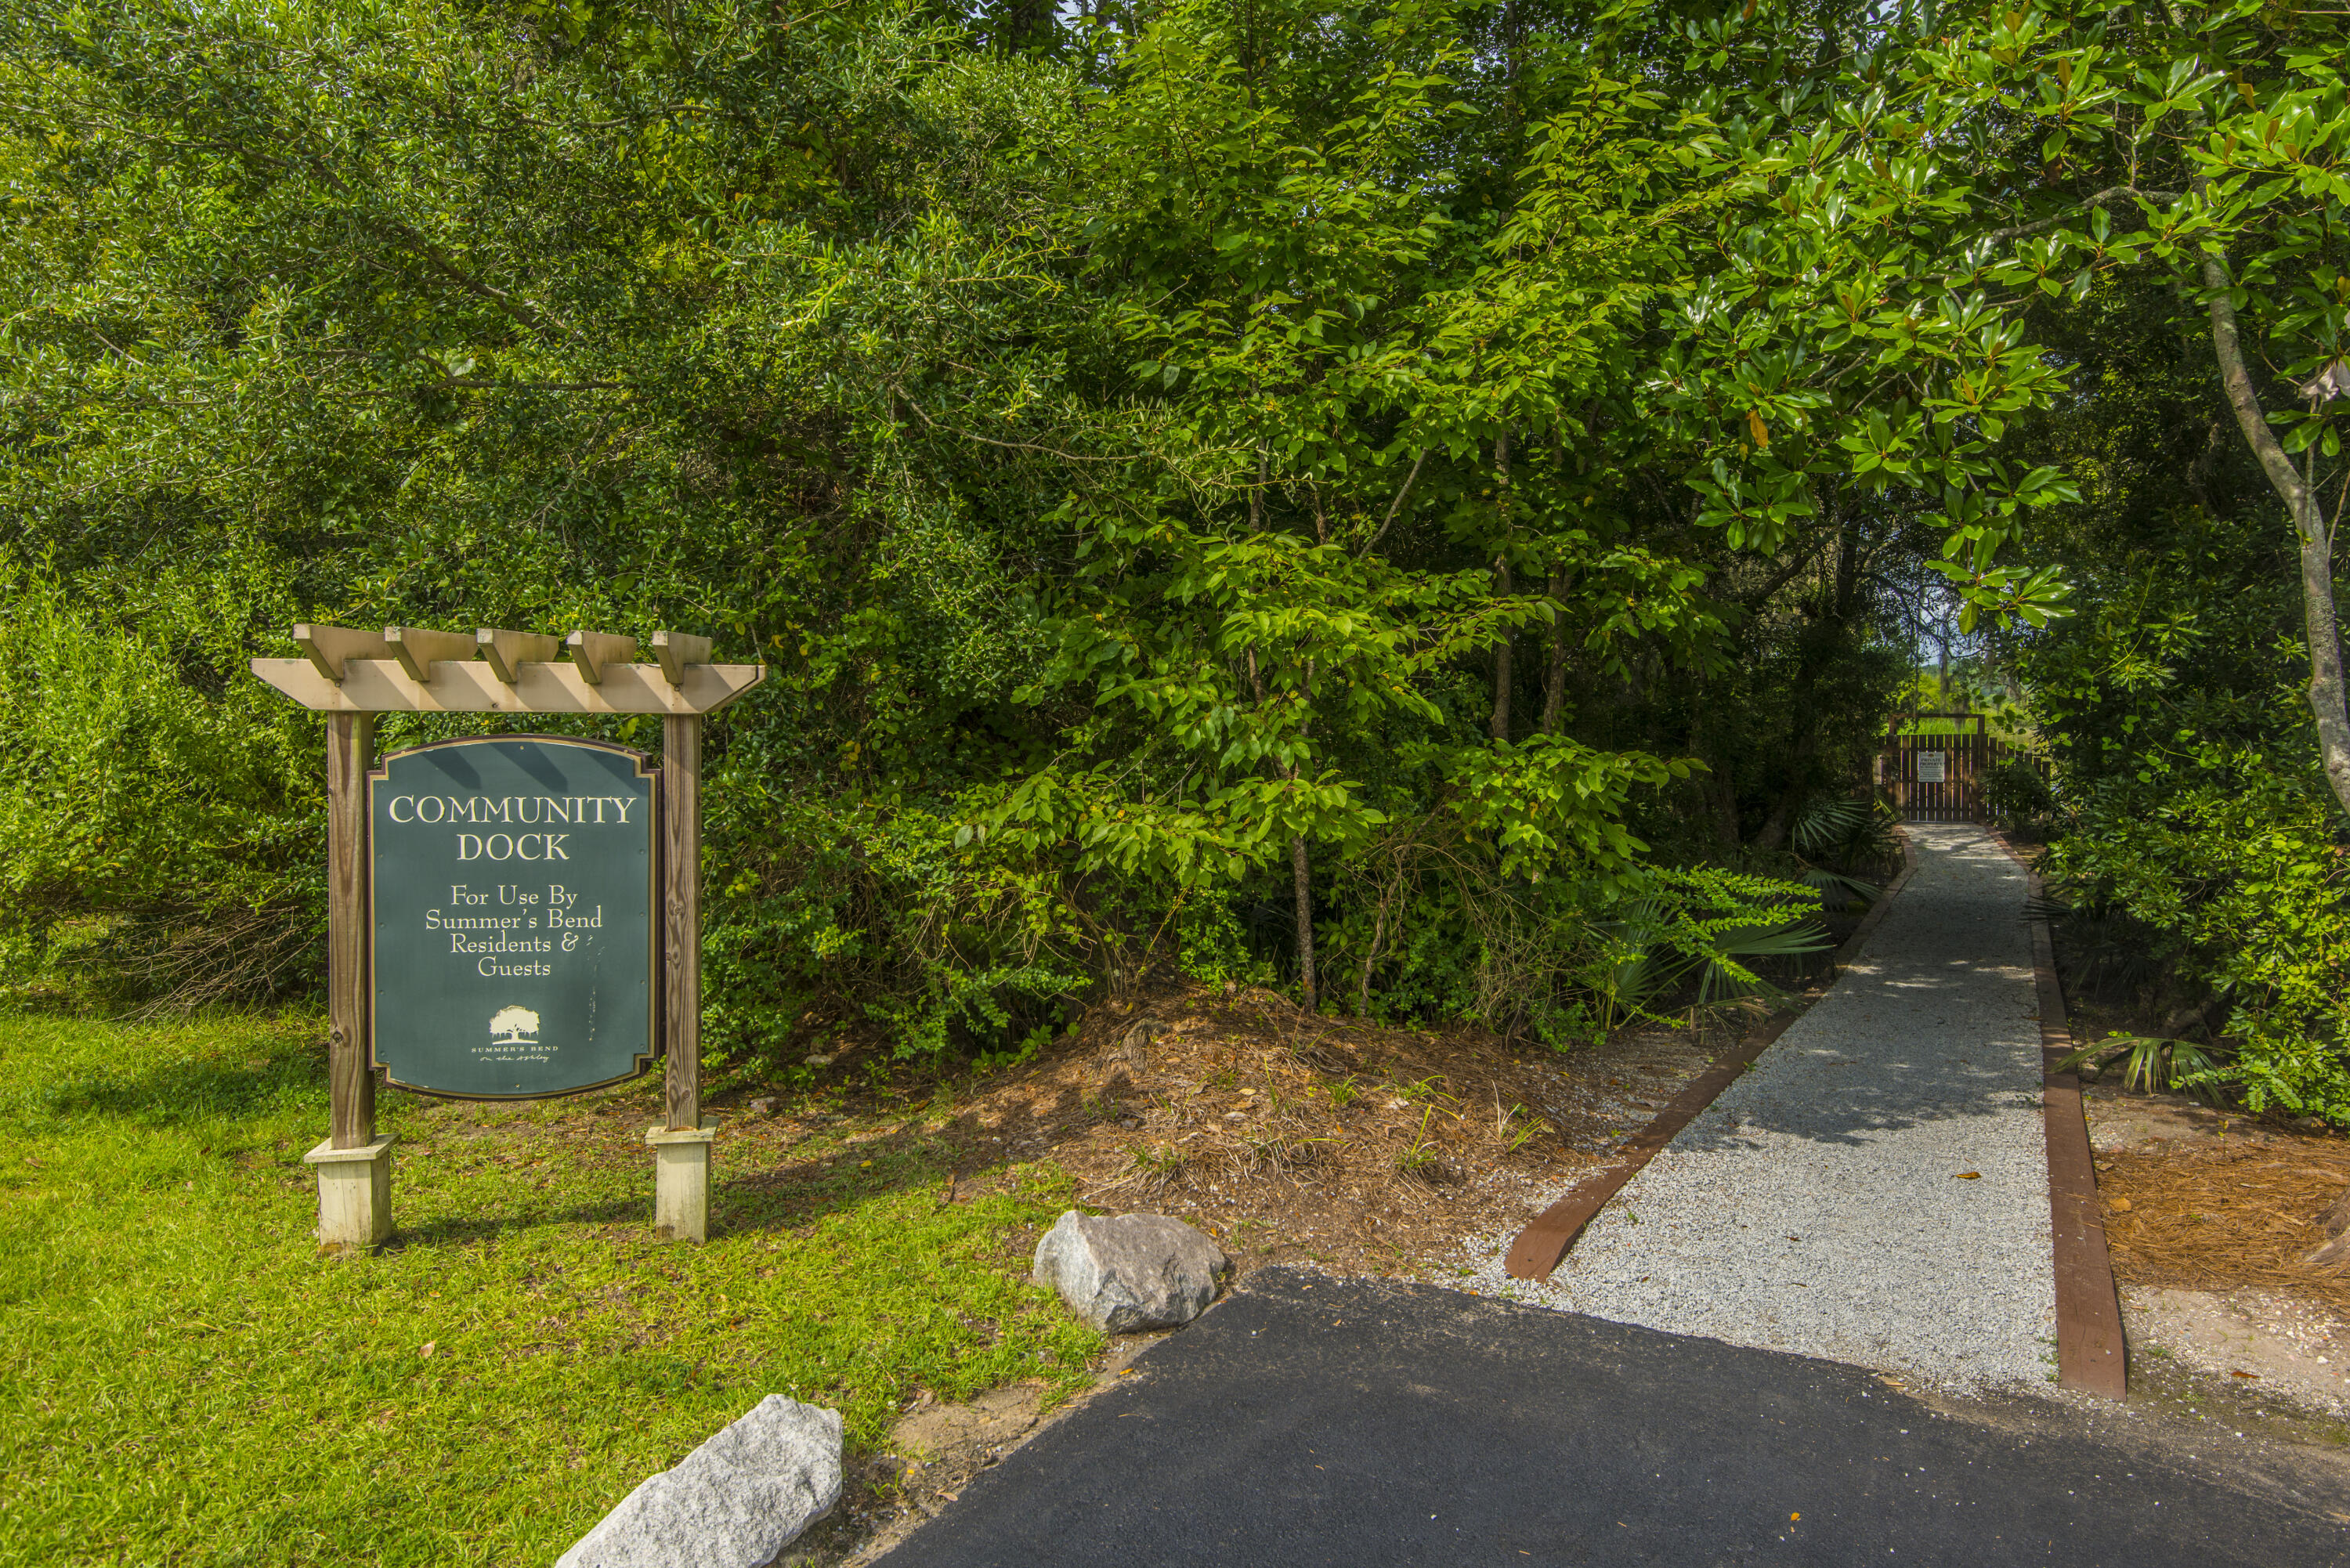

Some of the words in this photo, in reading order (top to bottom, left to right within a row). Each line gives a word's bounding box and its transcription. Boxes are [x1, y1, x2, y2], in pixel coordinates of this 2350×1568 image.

[389, 794, 638, 823] COMMUNITY
[456, 833, 570, 861] DOCK
[450, 883, 490, 905] For
[497, 884, 539, 905] Use
[547, 884, 578, 911] By
[425, 908, 537, 930] Summer's
[547, 905, 602, 928] Bend
[450, 930, 551, 953] Residents
[561, 931, 579, 952] &
[477, 955, 551, 977] Guests
